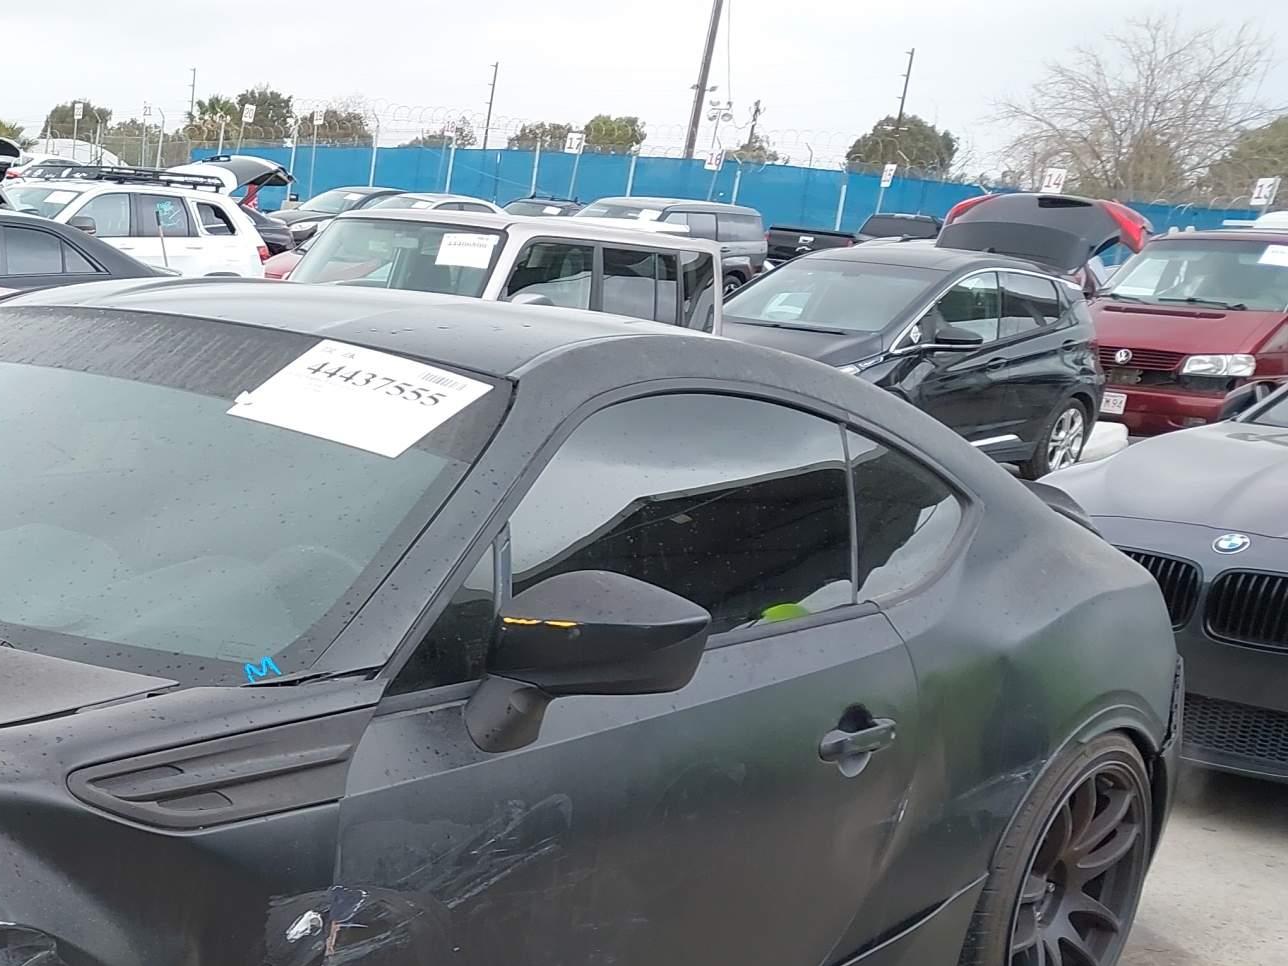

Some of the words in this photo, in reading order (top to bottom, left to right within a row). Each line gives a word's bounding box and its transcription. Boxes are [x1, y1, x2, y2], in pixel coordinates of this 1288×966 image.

[567, 137, 583, 150] 17
[1044, 173, 1063, 188] 14
[306, 361, 447, 407] 44437555
